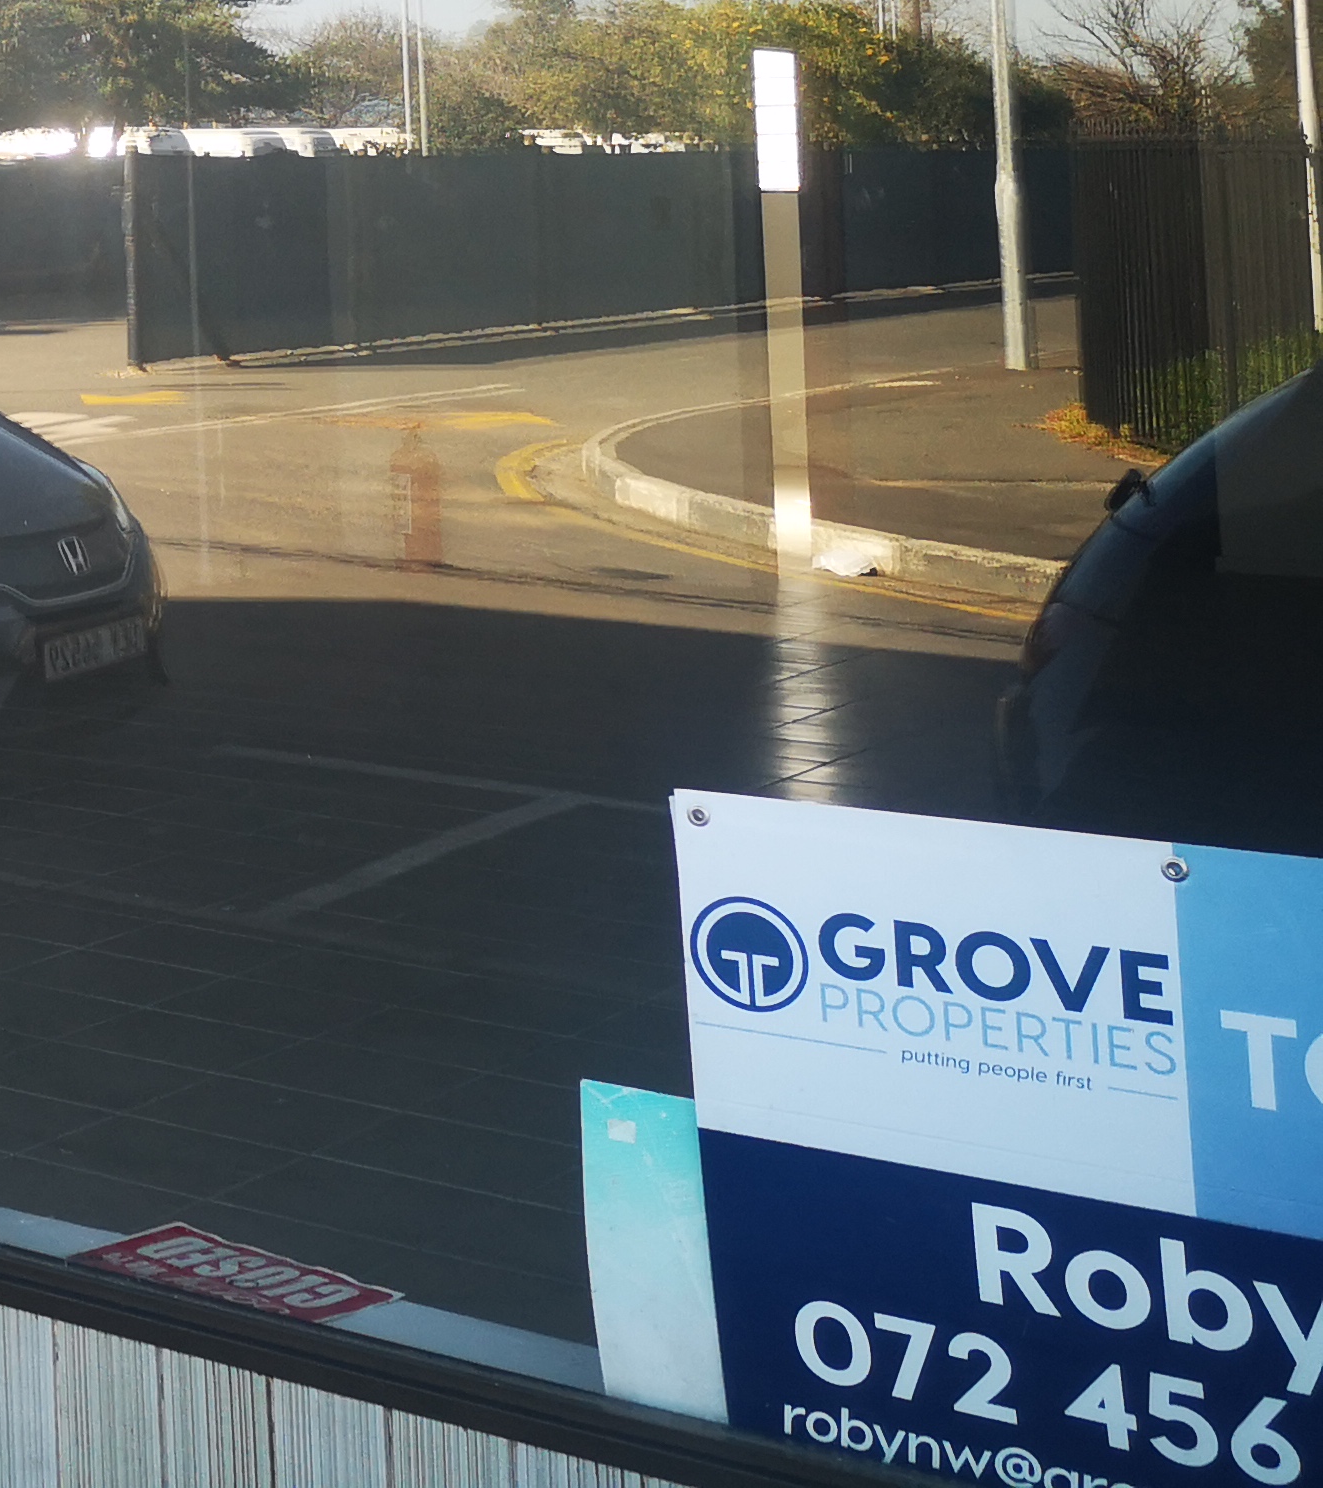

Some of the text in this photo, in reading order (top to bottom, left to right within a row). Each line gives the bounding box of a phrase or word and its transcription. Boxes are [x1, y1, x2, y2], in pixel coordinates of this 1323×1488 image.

[817, 912, 1174, 1027] GROVE
[819, 982, 1178, 1076] PROPERTIES
[900, 1047, 1093, 1092] putting people first
[794, 1300, 1301, 1488] 072 456
